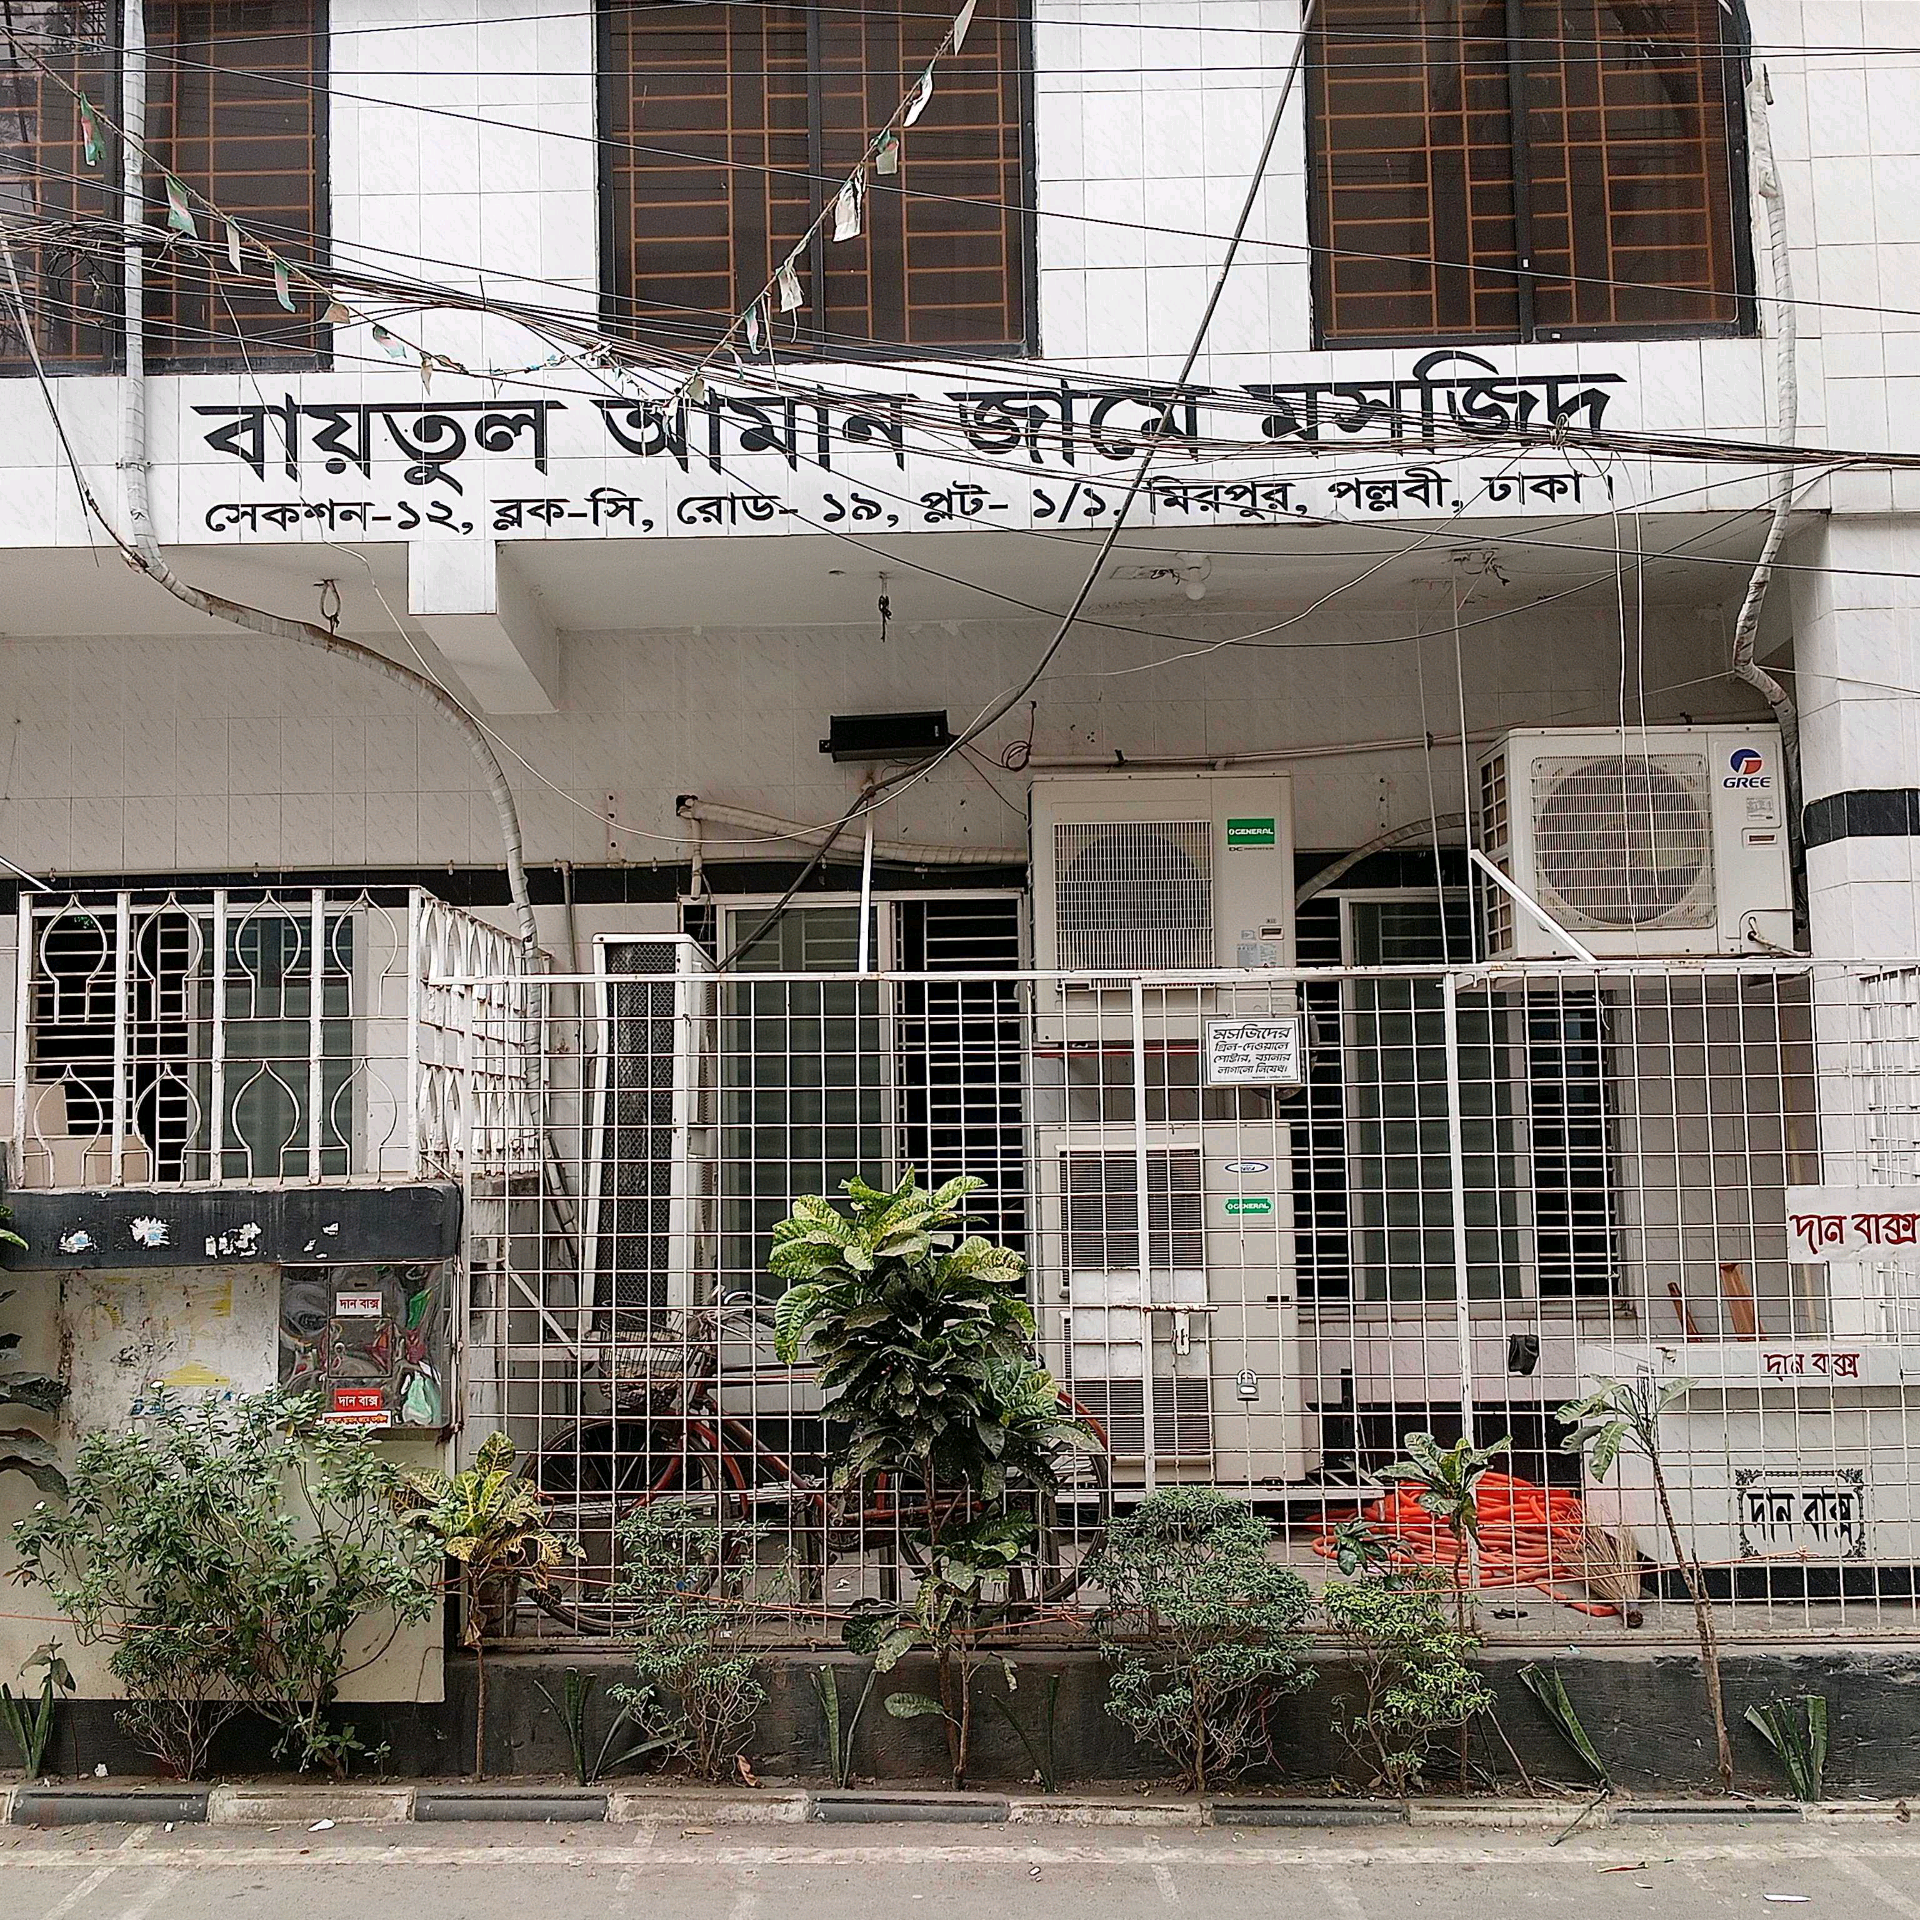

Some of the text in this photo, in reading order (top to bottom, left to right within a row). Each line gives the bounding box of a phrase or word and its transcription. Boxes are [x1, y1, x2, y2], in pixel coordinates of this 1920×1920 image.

[190, 350, 1627, 496] বায়তুল আমান জামে মসজিদ
[206, 498, 473, 534] সেকশন-১২,
[490, 487, 654, 532] ব্লক-সি,
[1142, 475, 1307, 521] মিরপুর,
[1329, 468, 1464, 513] পল্লবী,
[1723, 776, 1772, 788] GREE
[1213, 1023, 1292, 1040] মসজিদের
[1217, 1065, 1254, 1074] লাগানো
[1788, 1214, 1847, 1254] দান
[338, 1298, 380, 1309] দান বাক্স
[1763, 1353, 1805, 1382] দান
[337, 1395, 379, 1407] দান বাক্স
[1746, 1487, 1795, 1542] দান
